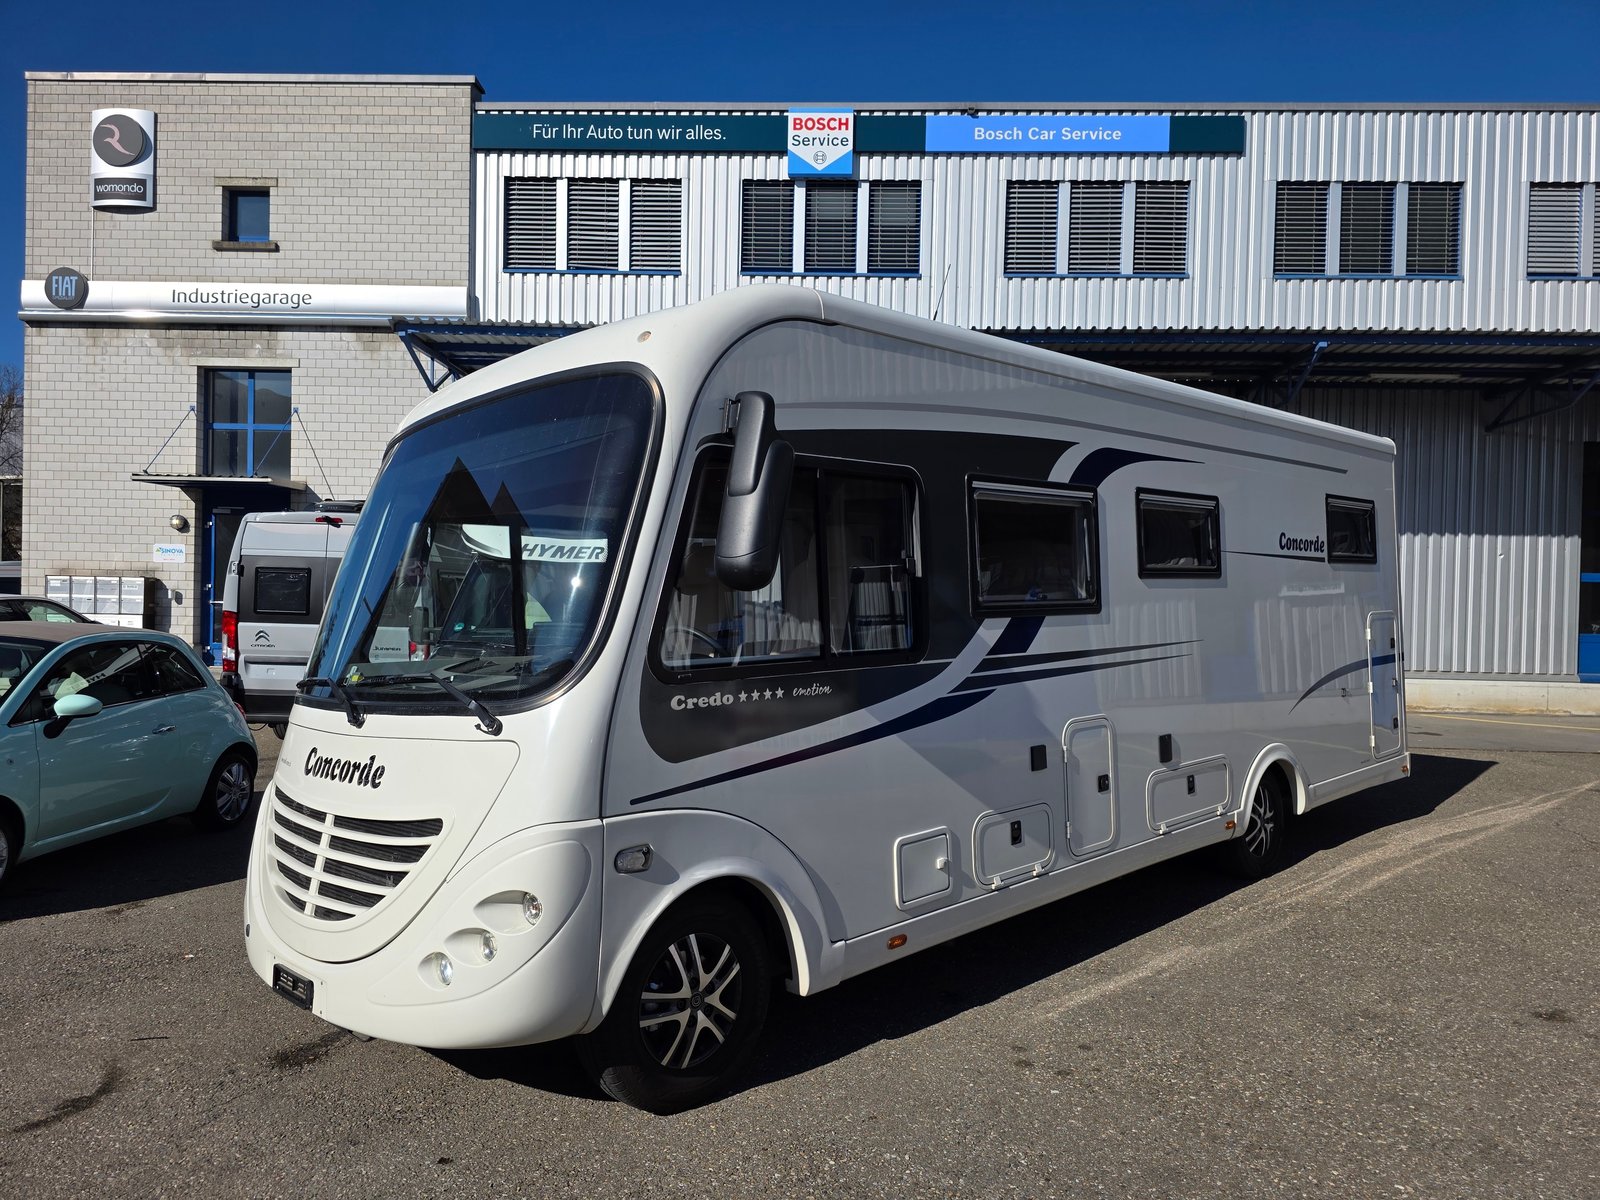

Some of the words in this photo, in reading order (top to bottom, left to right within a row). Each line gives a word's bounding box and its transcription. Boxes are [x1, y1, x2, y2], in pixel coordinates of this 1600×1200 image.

[533, 124, 558, 139] Für
[563, 124, 584, 139] Ihr
[586, 125, 623, 140] Auto
[627, 125, 653, 140] tun
[657, 125, 682, 140] wir
[685, 125, 726, 140] alles.
[792, 117, 849, 131] BOSCH
[791, 133, 849, 147] Service
[974, 127, 1022, 140] Bosch
[1028, 127, 1056, 140] Car
[1061, 127, 1122, 140] Service
[96, 183, 143, 193] womondo
[52, 275, 78, 297] FIAT
[171, 288, 312, 309] Industriegarage
[1279, 531, 1325, 553] Concorde
[521, 543, 606, 560] HYMER
[670, 691, 735, 711] Credo
[792, 682, 832, 697] emotion
[304, 746, 386, 789] Concorde
